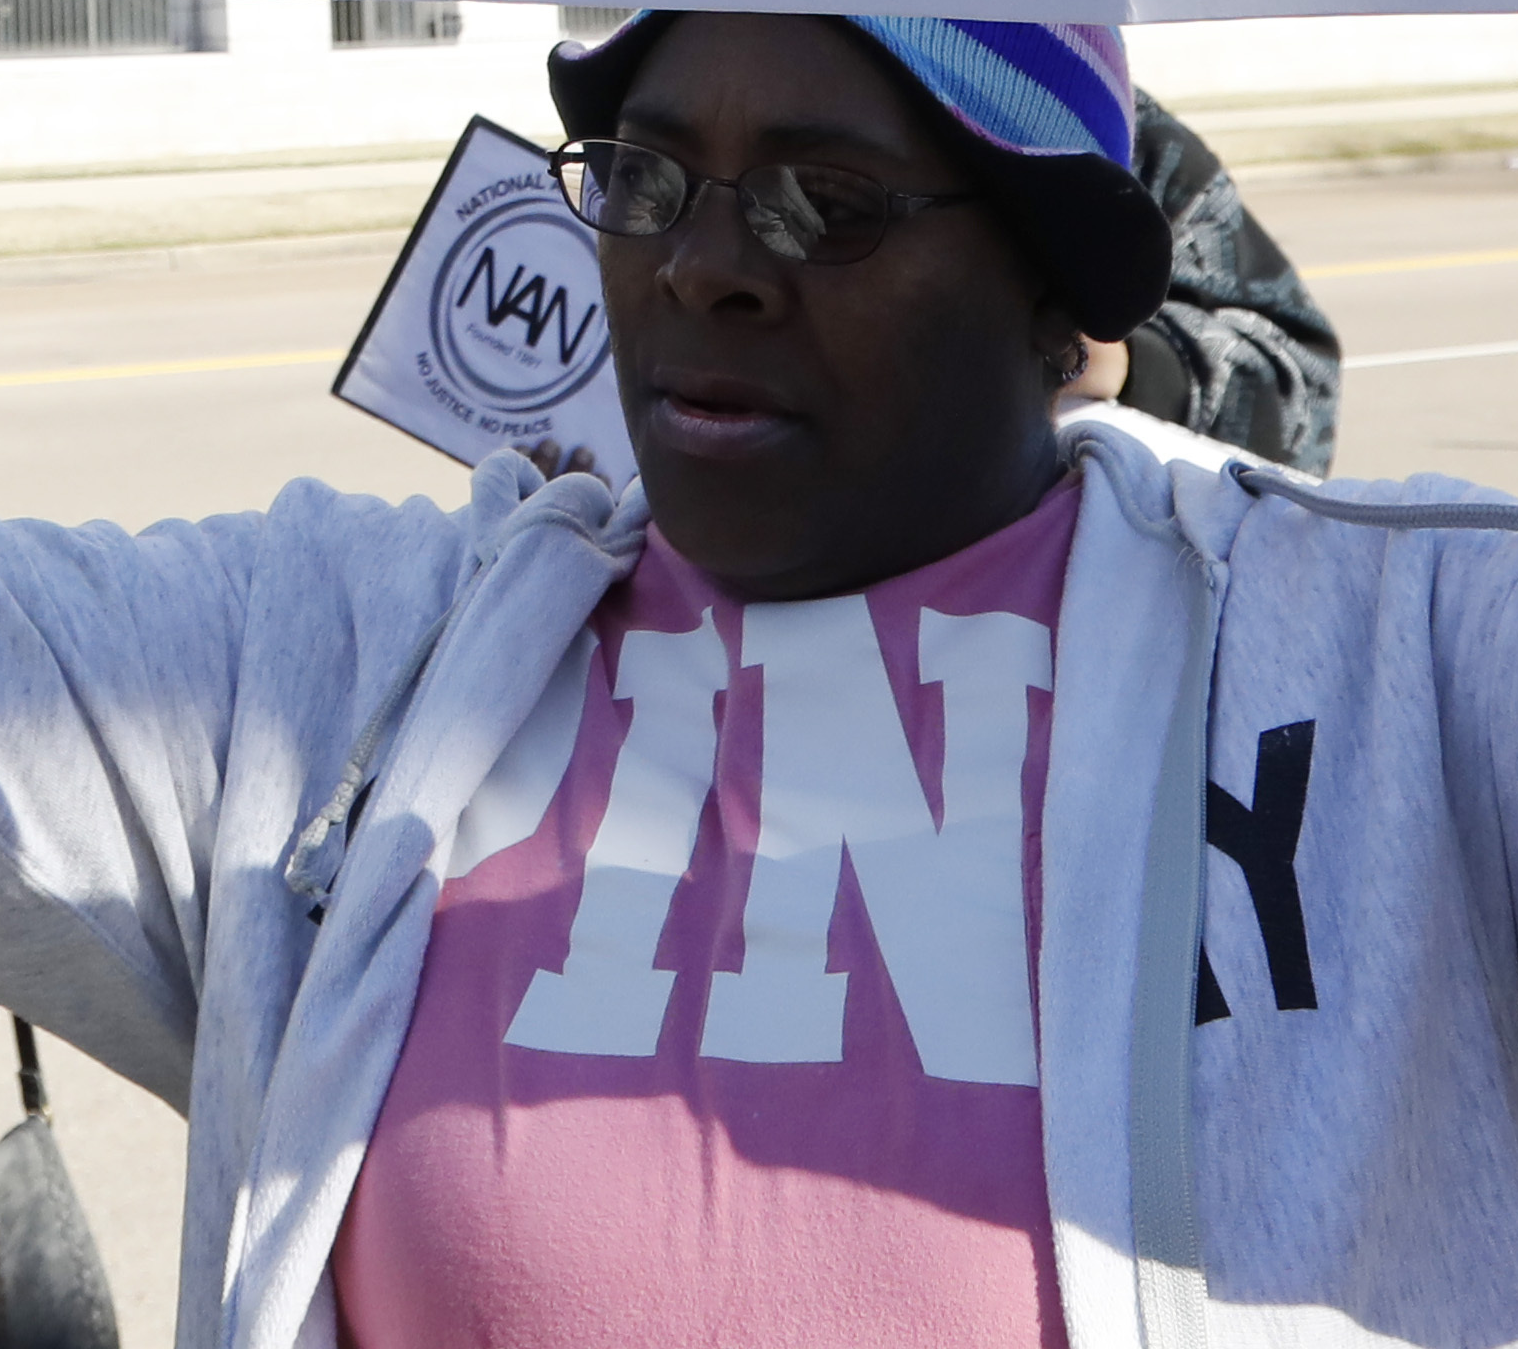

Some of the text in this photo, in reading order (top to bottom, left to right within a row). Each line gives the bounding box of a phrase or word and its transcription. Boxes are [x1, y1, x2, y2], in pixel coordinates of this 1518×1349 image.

[456, 173, 545, 222] NATIONAL
[456, 246, 597, 366] NAN
[425, 379, 475, 424] JUSTICE
[502, 417, 554, 437] PEACE
